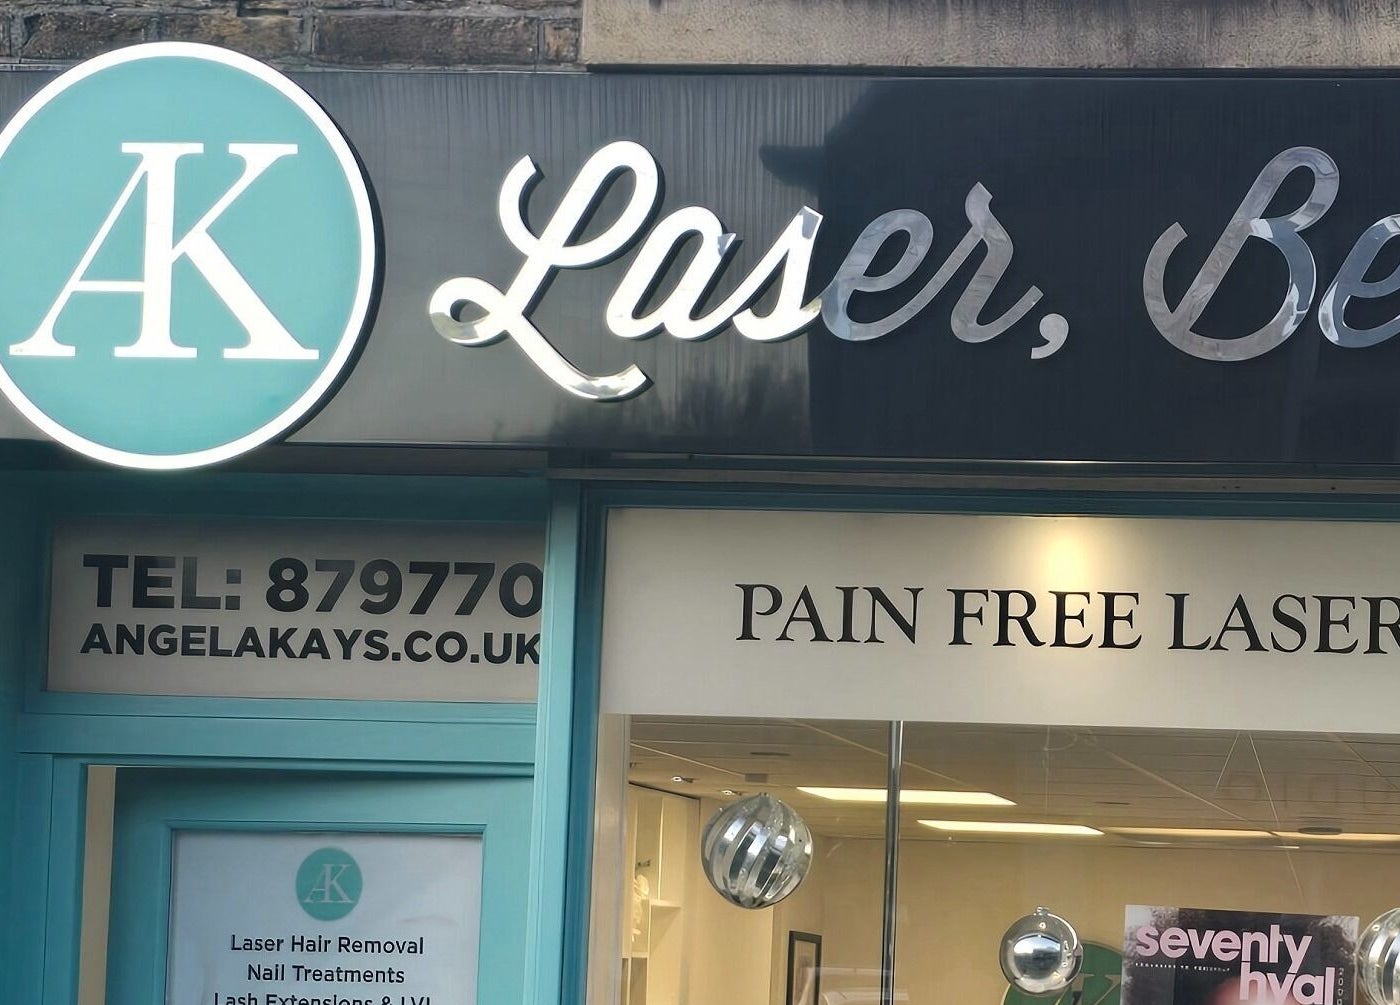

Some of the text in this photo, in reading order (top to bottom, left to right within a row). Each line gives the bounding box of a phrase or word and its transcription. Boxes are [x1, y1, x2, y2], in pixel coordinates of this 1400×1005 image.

[9, 141, 320, 360] AK
[428, 140, 1070, 402] Laser,
[82, 553, 544, 619] TEL: 879770
[734, 583, 924, 645] PAIN
[946, 588, 1142, 650] FREE
[79, 622, 542, 666] ANGELAKAYS.CO.UK
[304, 863, 353, 904] AK
[230, 934, 424, 955] Laser Hair Removal
[1136, 924, 1313, 974] seventy
[247, 964, 405, 984] Nail Treatments
